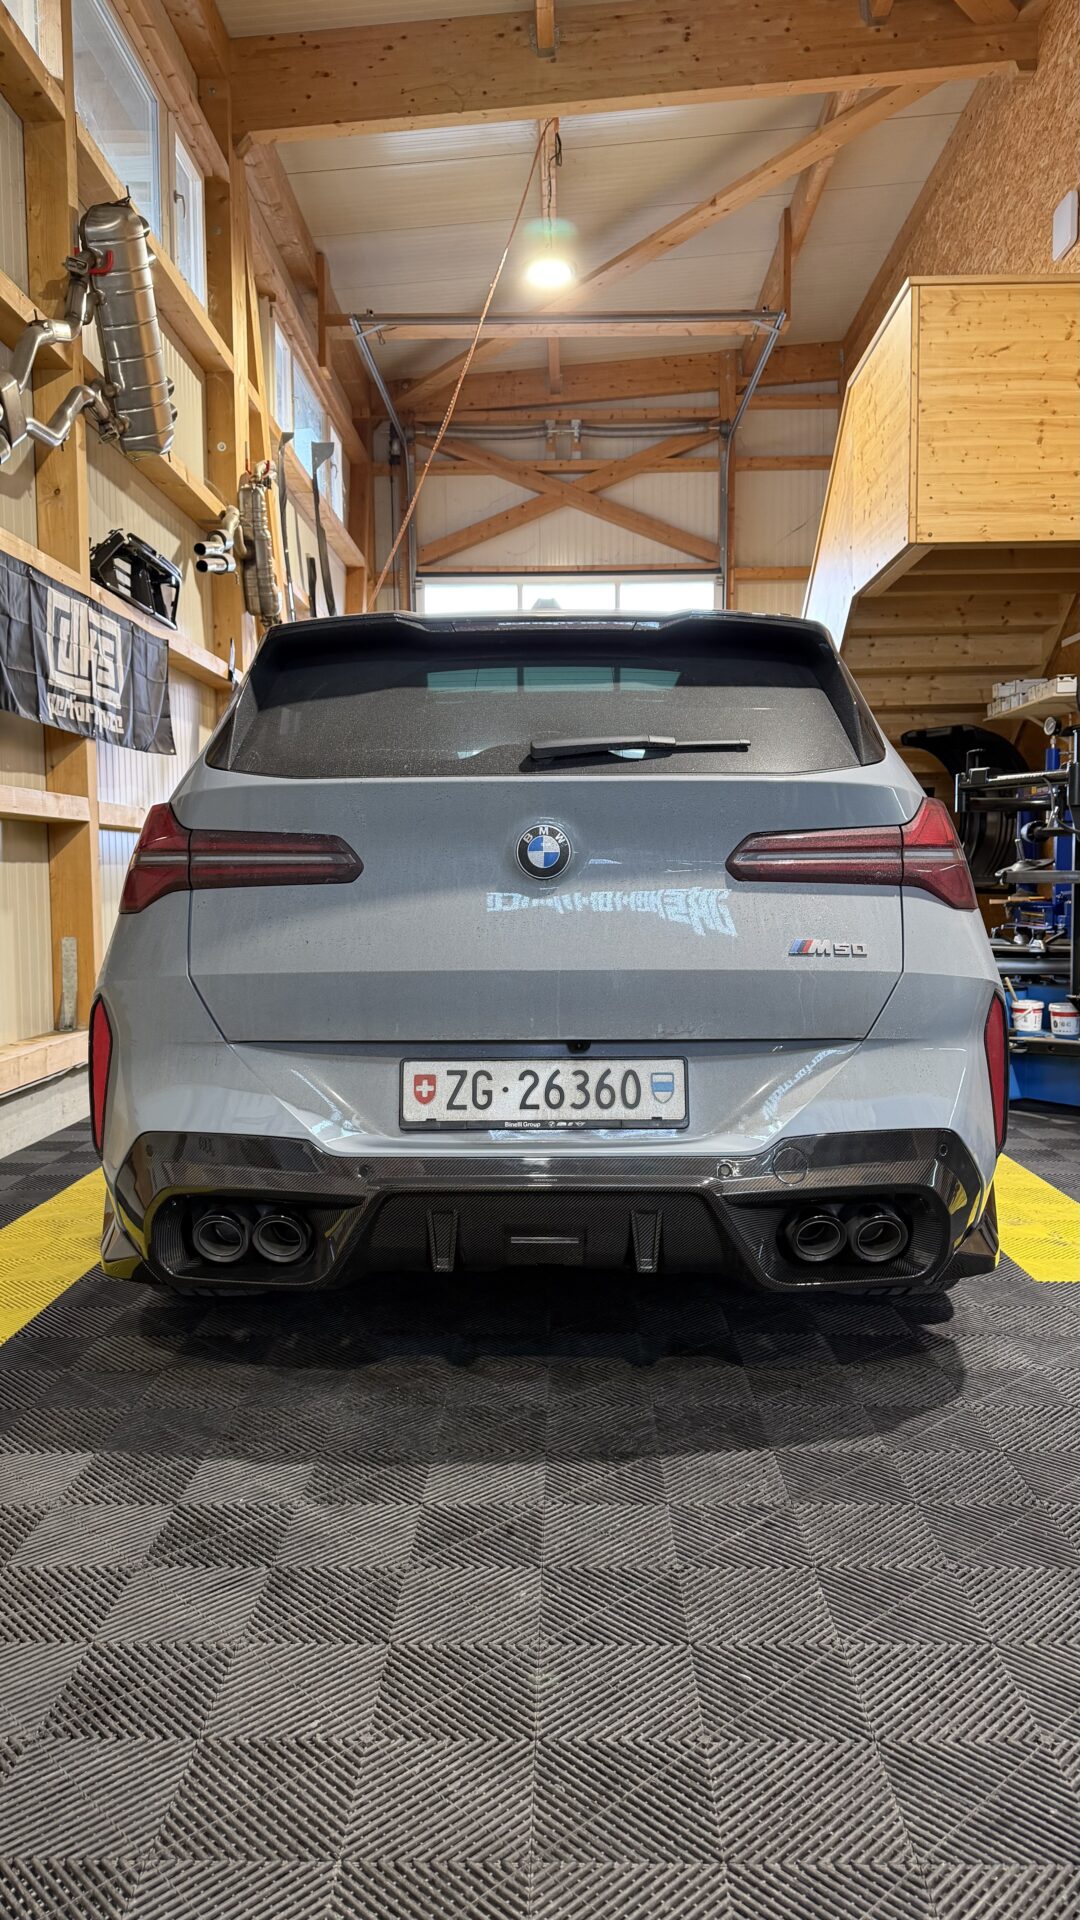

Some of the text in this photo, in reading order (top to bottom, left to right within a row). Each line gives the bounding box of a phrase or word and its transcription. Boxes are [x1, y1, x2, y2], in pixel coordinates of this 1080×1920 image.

[522, 826, 566, 844] BMW
[806, 939, 868, 958] M50
[523, 1121, 541, 1129] Group
